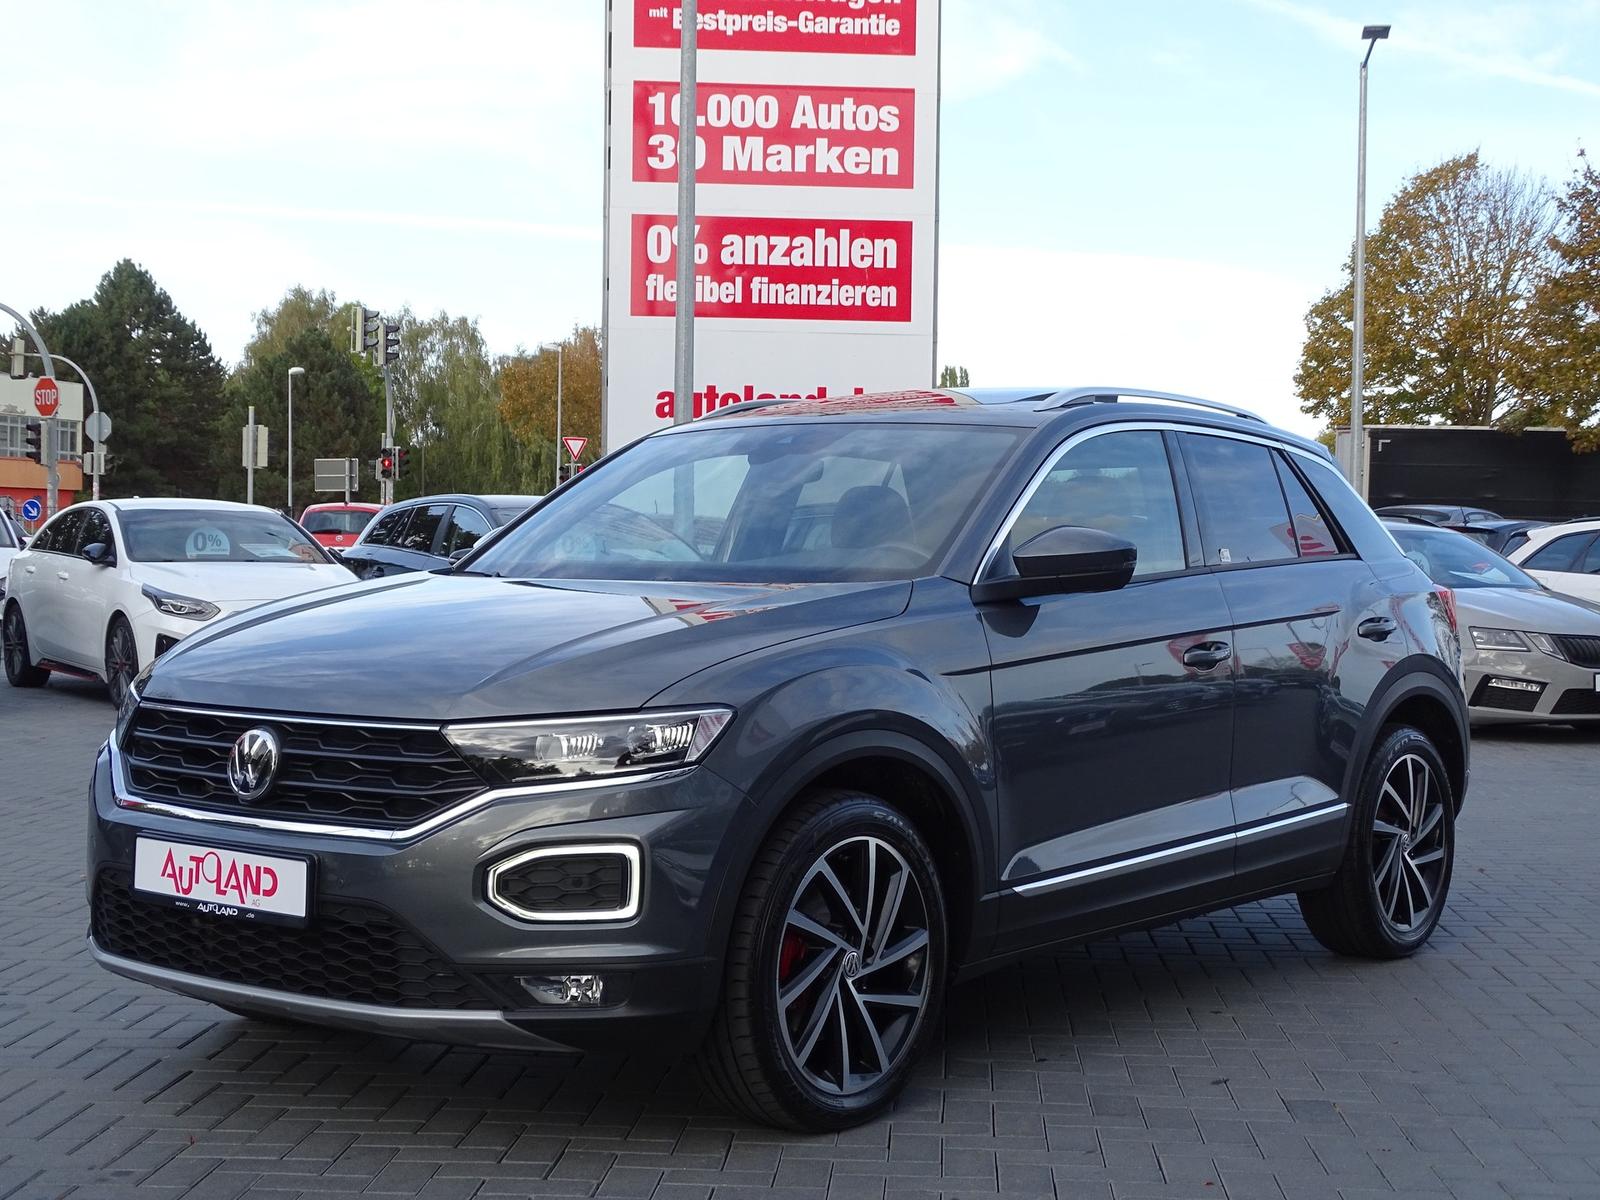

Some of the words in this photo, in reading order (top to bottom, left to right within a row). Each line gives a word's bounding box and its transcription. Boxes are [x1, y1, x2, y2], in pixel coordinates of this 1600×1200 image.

[649, 7, 668, 18] mit
[790, 96, 900, 132] Autos
[722, 135, 899, 176] Marken
[720, 228, 897, 269] anzahlen
[645, 274, 742, 304] fleibel
[750, 276, 897, 307] finanzieren
[35, 389, 57, 406] STOP
[160, 847, 279, 905] AUTOLAND
[197, 902, 238, 916] AUTOLAND
